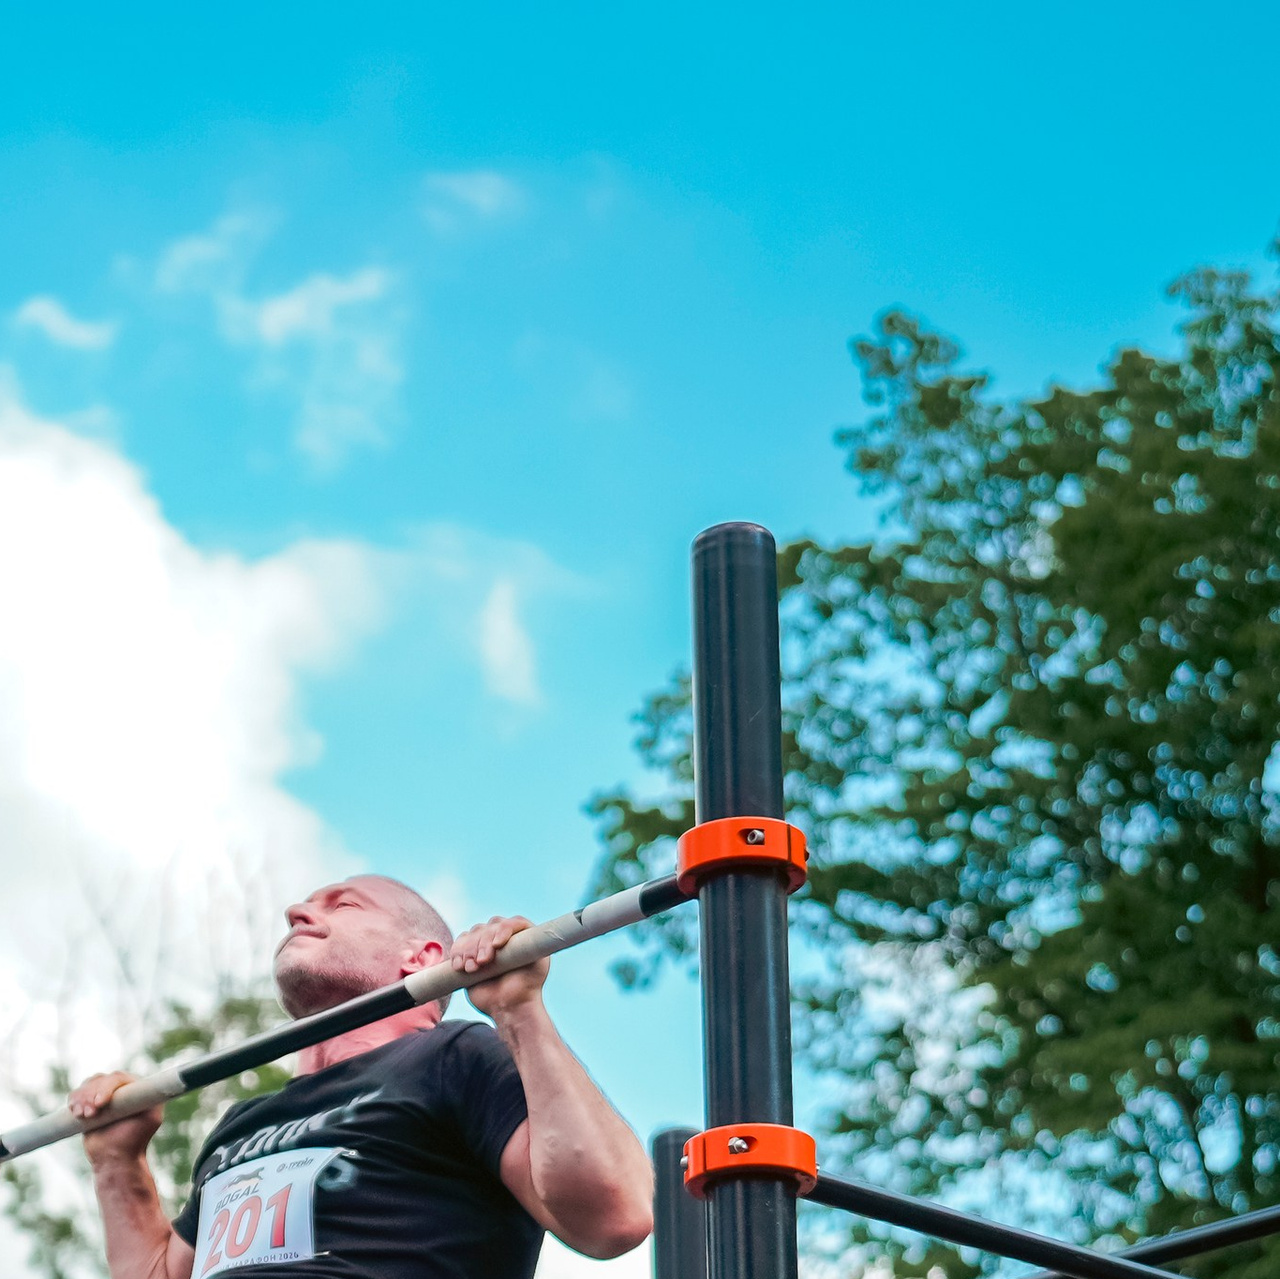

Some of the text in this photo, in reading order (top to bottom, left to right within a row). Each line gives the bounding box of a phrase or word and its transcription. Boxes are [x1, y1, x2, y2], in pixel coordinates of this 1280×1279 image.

[214, 1183, 260, 1215] BOGAL
[200, 1183, 293, 1278] 201
[279, 1251, 299, 1260] 2026
